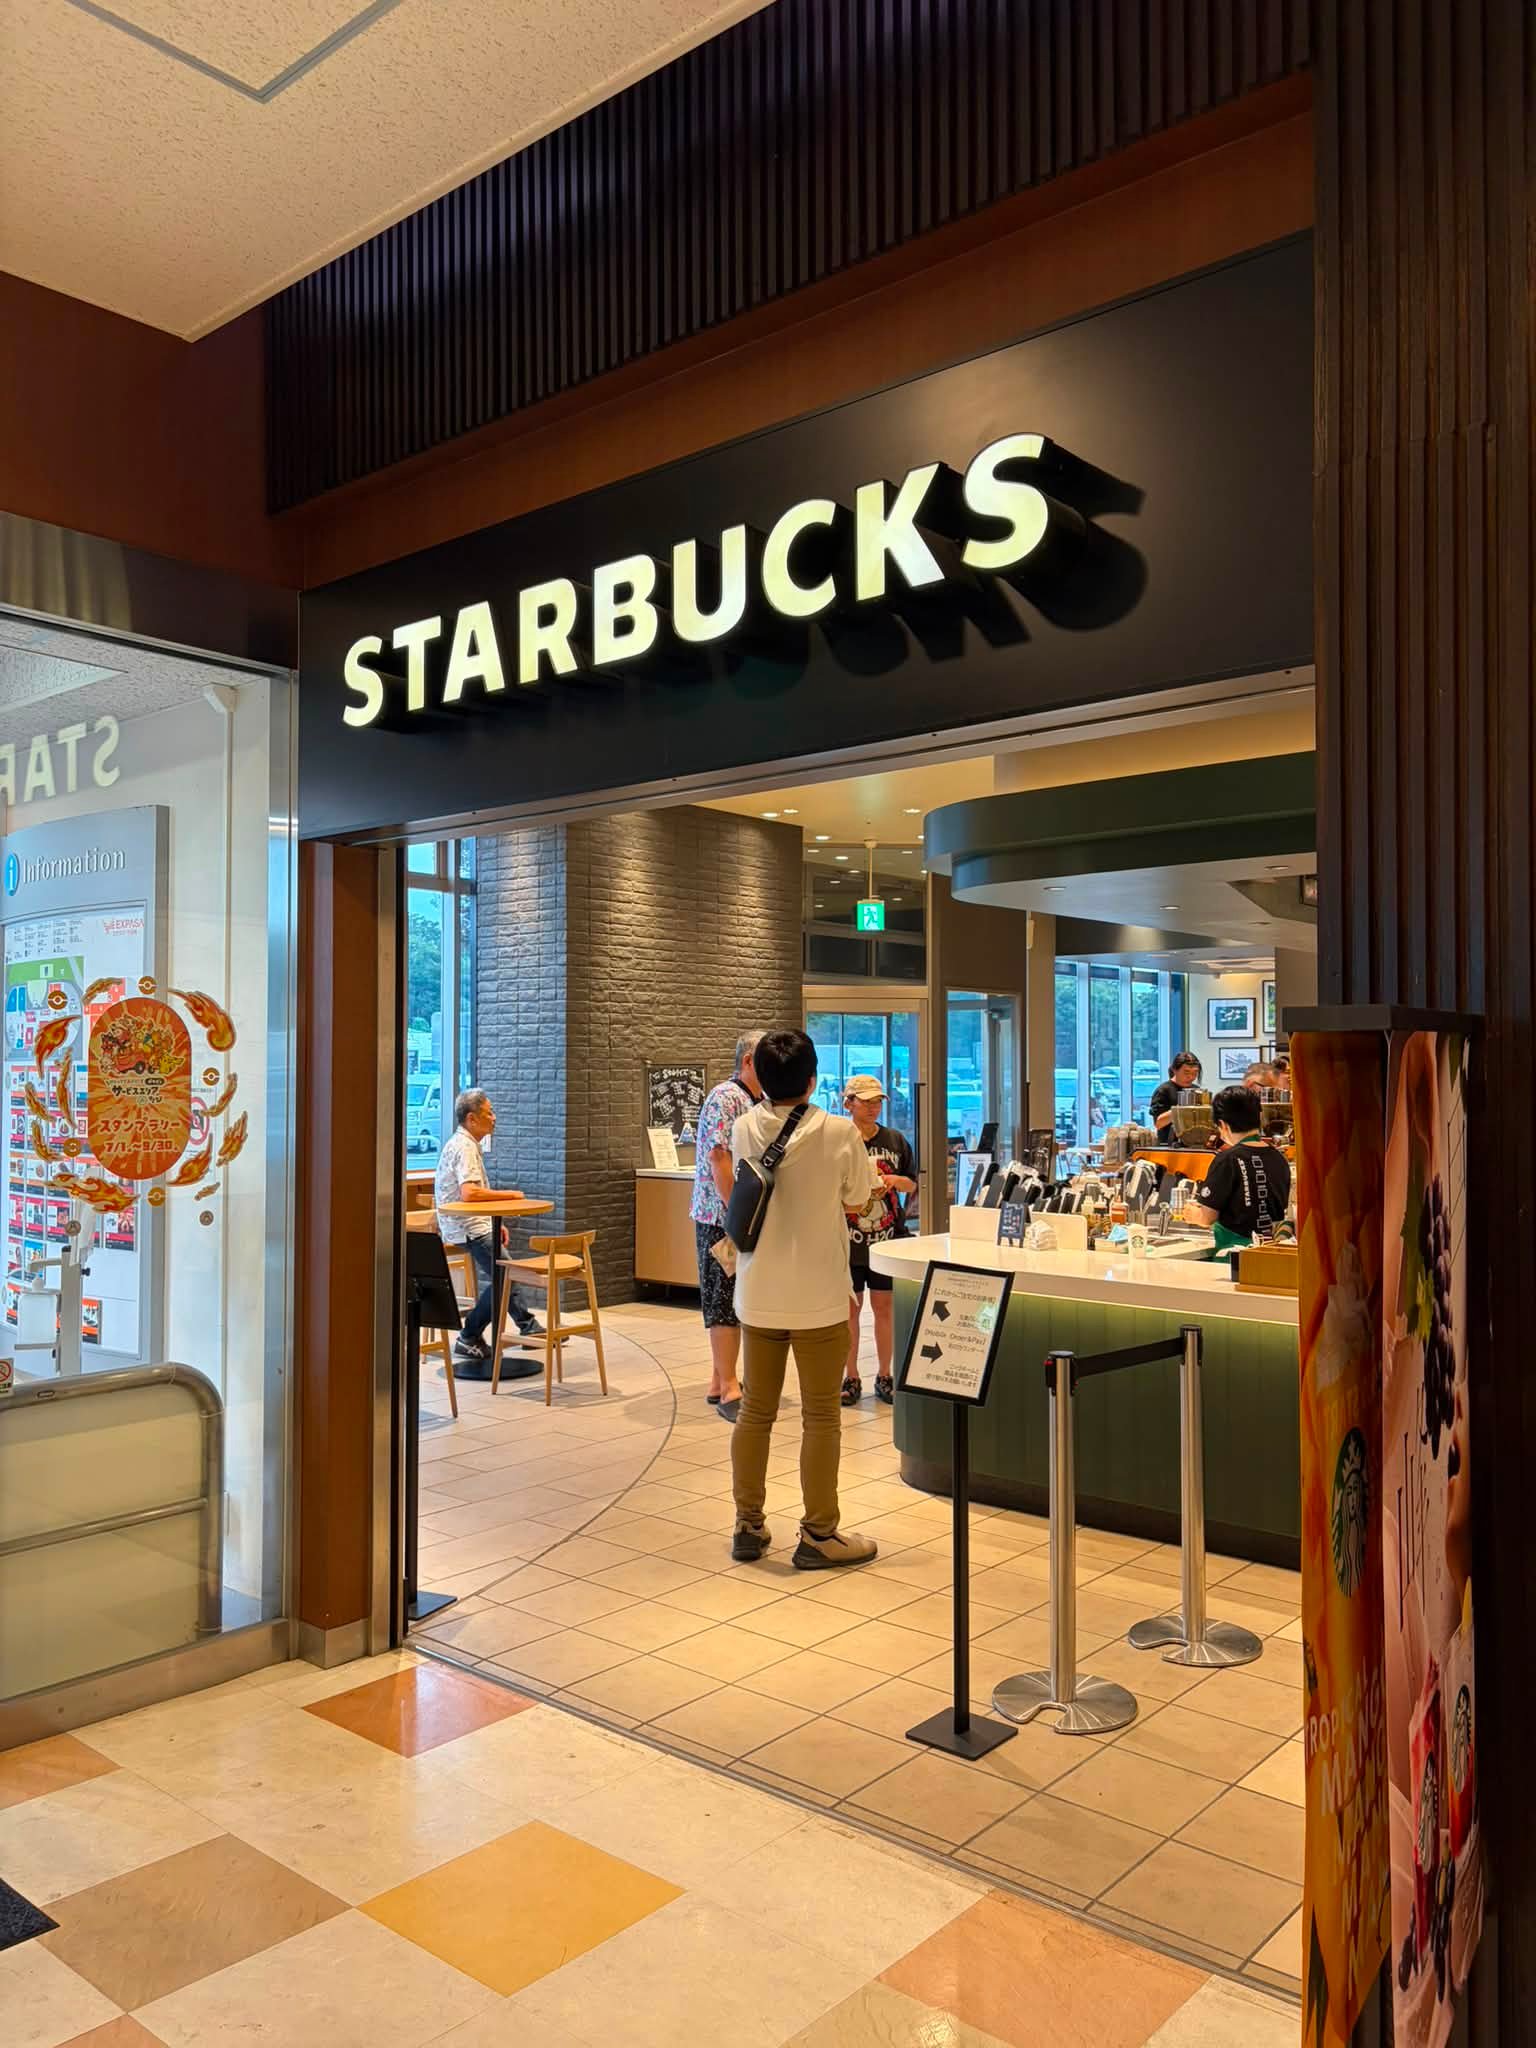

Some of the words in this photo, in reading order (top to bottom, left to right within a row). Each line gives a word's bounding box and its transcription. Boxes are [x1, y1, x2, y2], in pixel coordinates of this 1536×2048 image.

[343, 433, 1050, 728] STARBUCKS
[22, 847, 126, 883] Information
[100, 1116, 180, 1132] スタンプラリー
[1237, 1157, 1252, 1207] STARBUCKS
[1304, 1655, 1368, 1766] TROPICAL
